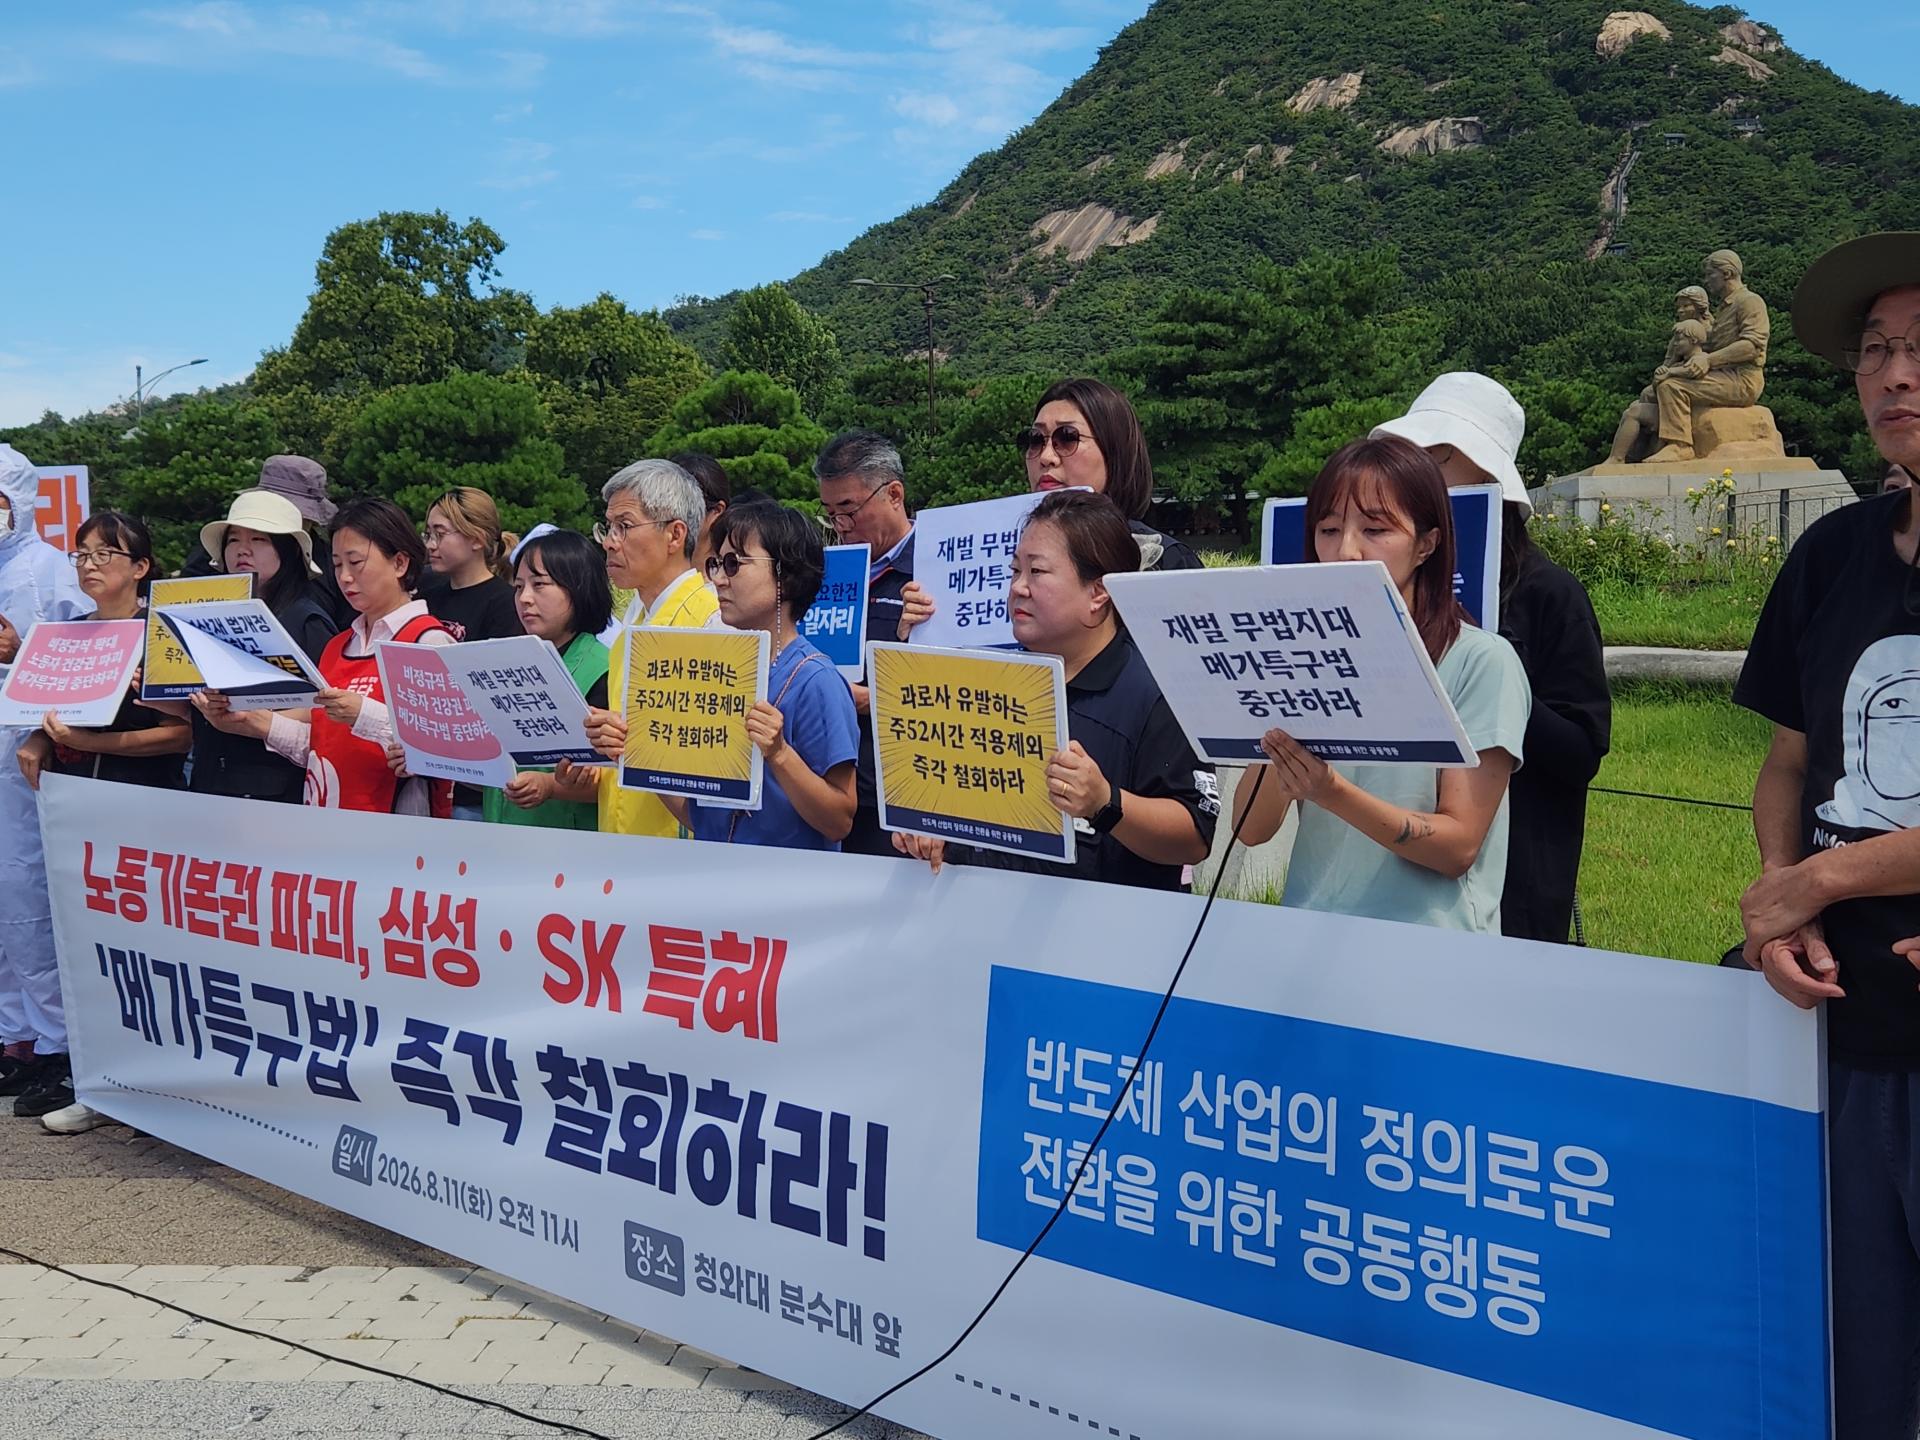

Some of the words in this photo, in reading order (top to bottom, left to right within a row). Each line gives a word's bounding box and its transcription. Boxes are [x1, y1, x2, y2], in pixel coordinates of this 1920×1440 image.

[937, 534, 974, 562] 재벌
[980, 529, 1019, 557] 무법
[815, 582, 858, 602] 요한건
[948, 565, 1012, 594] 메가특
[224, 614, 271, 634] 법개정
[803, 605, 855, 636] 일자리
[955, 599, 1011, 627] 중단하
[1161, 612, 1229, 644] 재벌
[1230, 606, 1362, 642] 무법지대
[27, 652, 61, 671] 노동자
[164, 647, 184, 665] 즉각
[1200, 648, 1360, 681] 메가특구법
[70, 667, 119, 691] 중단하라
[403, 665, 446, 692] 비정규직
[467, 669, 498, 690] 재벌
[492, 665, 548, 688] 무법지대
[647, 657, 683, 681] 과로사
[687, 658, 738, 687] 유발하는
[396, 684, 429, 712] 노동자
[430, 696, 464, 716] 건강권
[490, 690, 558, 713] 메가특구법
[635, 689, 690, 713] 주52시간
[694, 691, 746, 717] 적용제외
[900, 684, 951, 710] 과로사
[956, 687, 1029, 725] 유발하는
[1236, 687, 1363, 718] 중단하라
[398, 706, 451, 741] 메가특구법
[512, 716, 569, 737] 중단하라
[648, 719, 673, 746] 즉각
[677, 725, 728, 749] 철회하라
[890, 717, 965, 749] 주52시간
[970, 727, 1044, 761] 적용제외
[912, 753, 948, 785] 즉각
[952, 763, 1025, 794] 철회하라
[84, 841, 262, 947] 노동기본권
[270, 870, 370, 980] 파괴,
[378, 886, 480, 988] 삼성
[536, 913, 626, 1013] SK
[642, 923, 788, 1043] 특혜
[95, 942, 379, 1103] '메가특구법'
[390, 1017, 523, 1146] 즉각
[535, 1043, 889, 1262] 철회하라!
[1025, 1036, 1164, 1137] 반도체
[1177, 1070, 1337, 1176] 산업의
[1359, 1104, 1615, 1239] 정의로운
[338, 1132, 372, 1179] 일시
[377, 1152, 493, 1222] 2026.8.11(화)
[499, 1196, 535, 1237] 오전
[540, 1209, 579, 1252] 11시
[1020, 1131, 1160, 1237] 전환을
[1175, 1170, 1284, 1268] 위한
[1300, 1199, 1546, 1337] 공동행동
[631, 1233, 679, 1282] 장소
[694, 1252, 770, 1314] 청와대
[779, 1279, 863, 1346] 분수대
[872, 1311, 902, 1359] 앞
